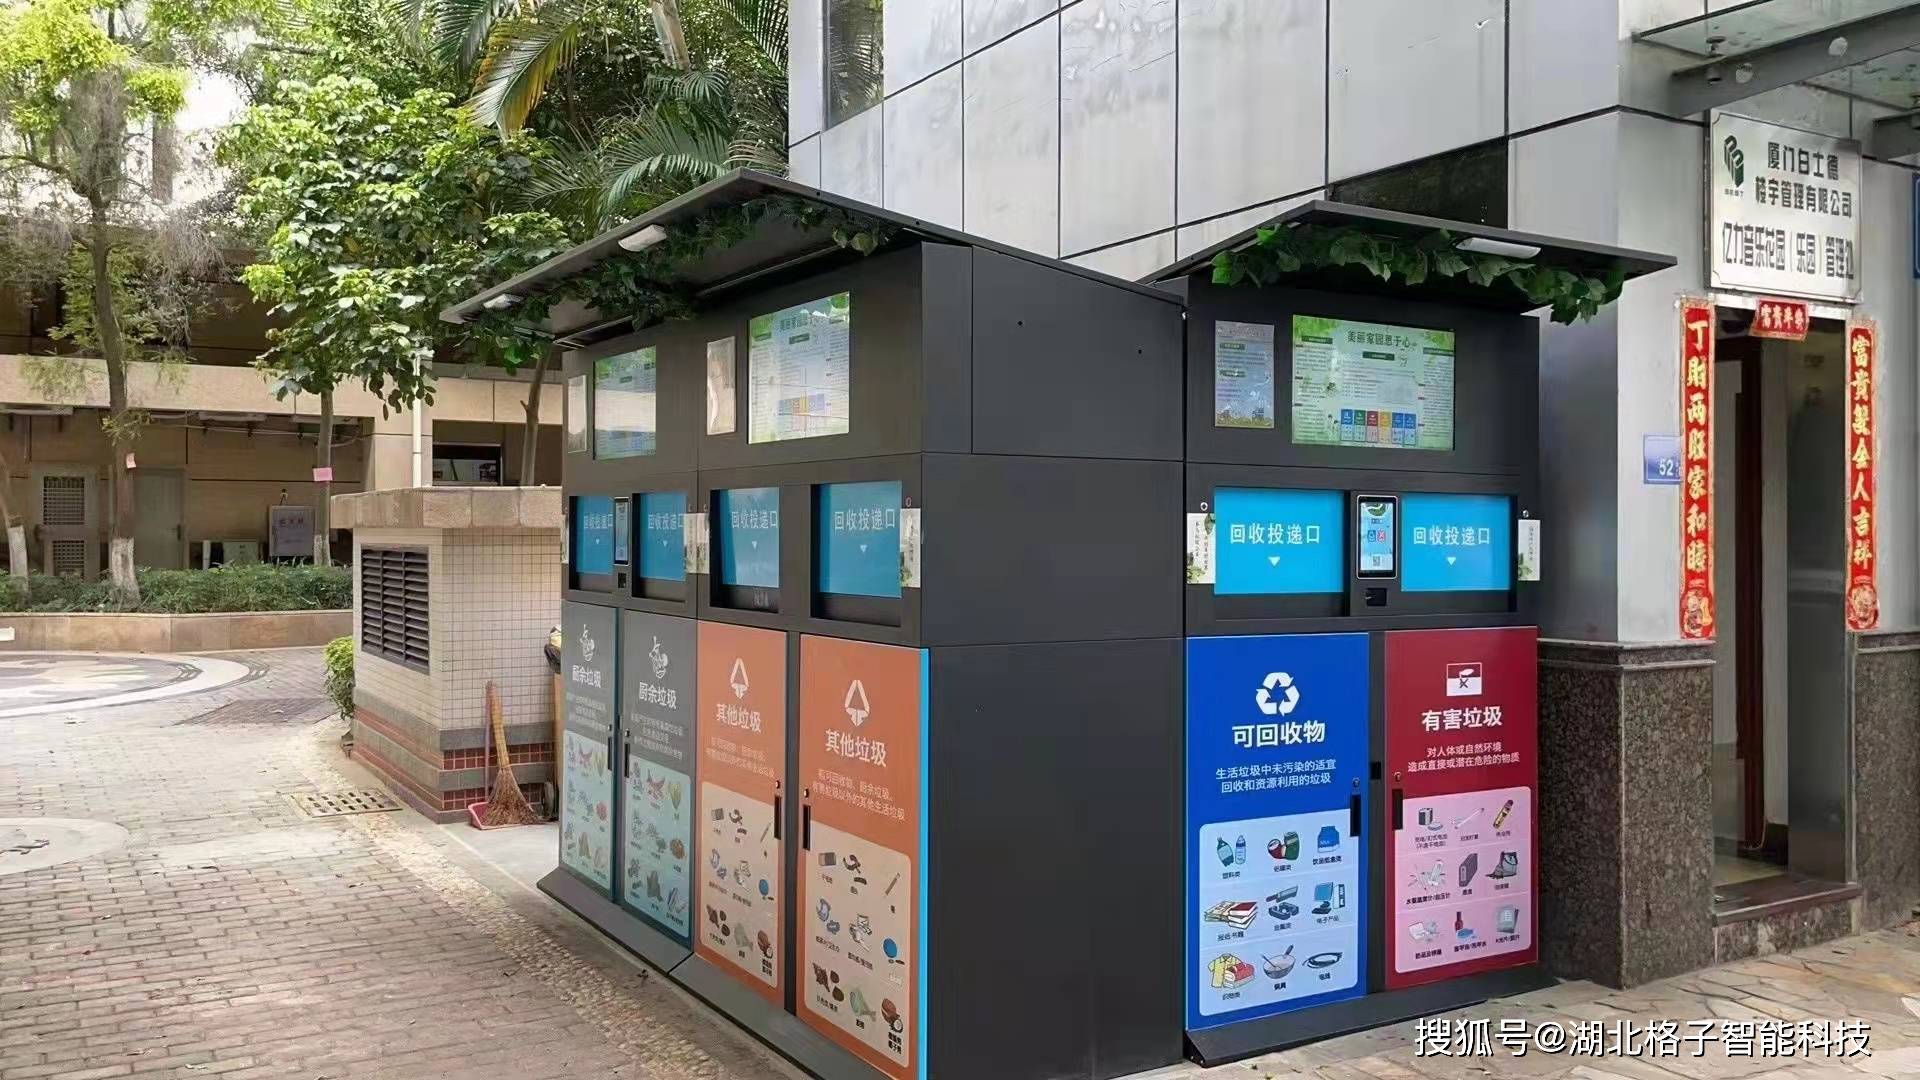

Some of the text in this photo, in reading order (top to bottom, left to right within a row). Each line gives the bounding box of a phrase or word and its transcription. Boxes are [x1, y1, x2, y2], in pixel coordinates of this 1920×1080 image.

[731, 510, 778, 529] 回收投递口
[834, 508, 896, 531] 回收投递口
[1230, 523, 1321, 545] 回收投递口
[1413, 526, 1491, 547] 回收投递口
[572, 664, 602, 689] 厨余垃圾
[639, 682, 677, 709] 厨余垃圾
[716, 703, 762, 733] 其他垃圾
[1421, 705, 1503, 731] 有害垃圾
[1231, 719, 1326, 748] 可回收物
[825, 729, 887, 768] 其他垃圾
[1427, 741, 1503, 758] 对人体或自然环境
[1215, 758, 1337, 780] 生活垃圾中未污染的适宜
[1408, 752, 1520, 773] 造成直接或潜在危险的物质
[1221, 772, 1332, 794] 回收和资源利用的垃圾
